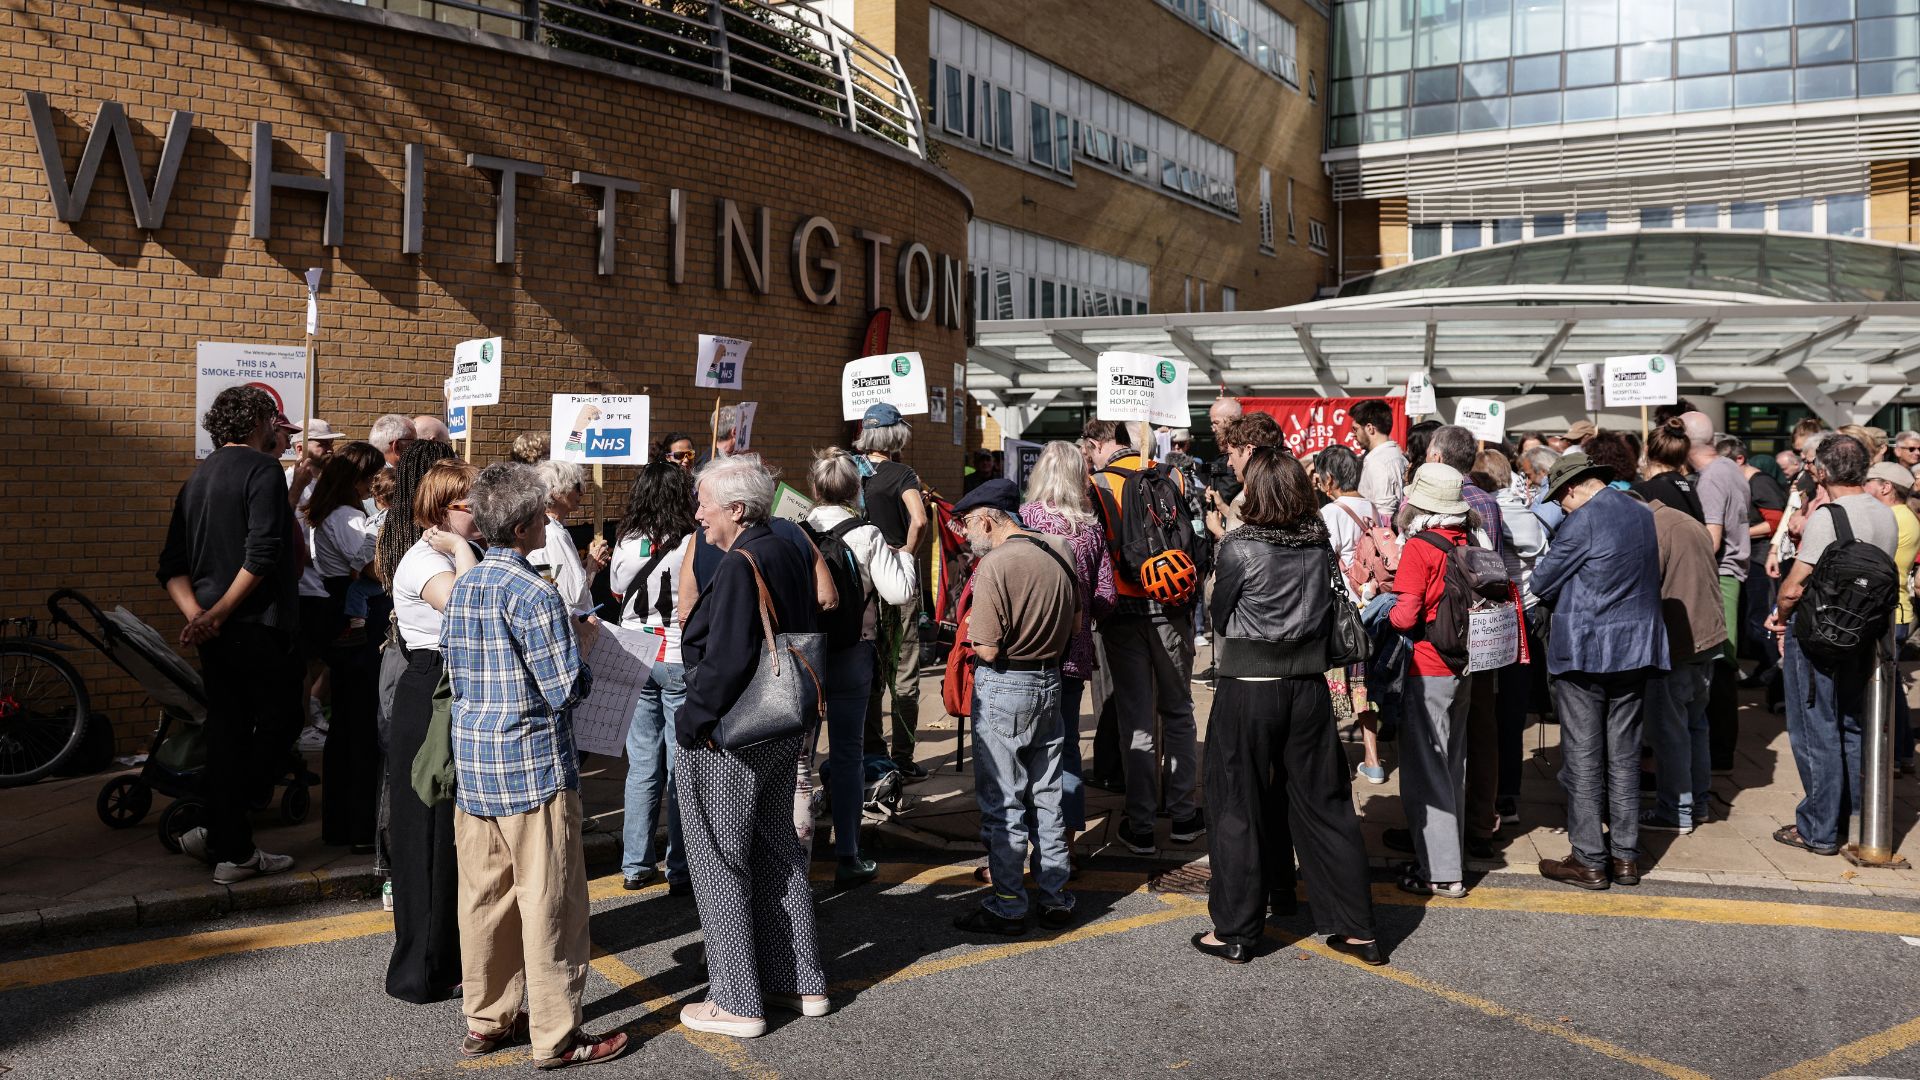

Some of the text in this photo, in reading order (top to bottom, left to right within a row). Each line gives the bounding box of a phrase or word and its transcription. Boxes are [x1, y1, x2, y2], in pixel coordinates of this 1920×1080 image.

[24, 91, 962, 331] WHITTINGTON
[236, 360, 256, 368] THIS
[202, 368, 264, 378] SMOKE-FREE
[860, 376, 890, 386] Palantir
[1122, 375, 1154, 388] Palantir
[450, 415, 464, 427] NHS
[591, 438, 624, 450] NHS
[1472, 638, 1500, 648] BOYCOTT
[1471, 652, 1484, 661] LIFT
